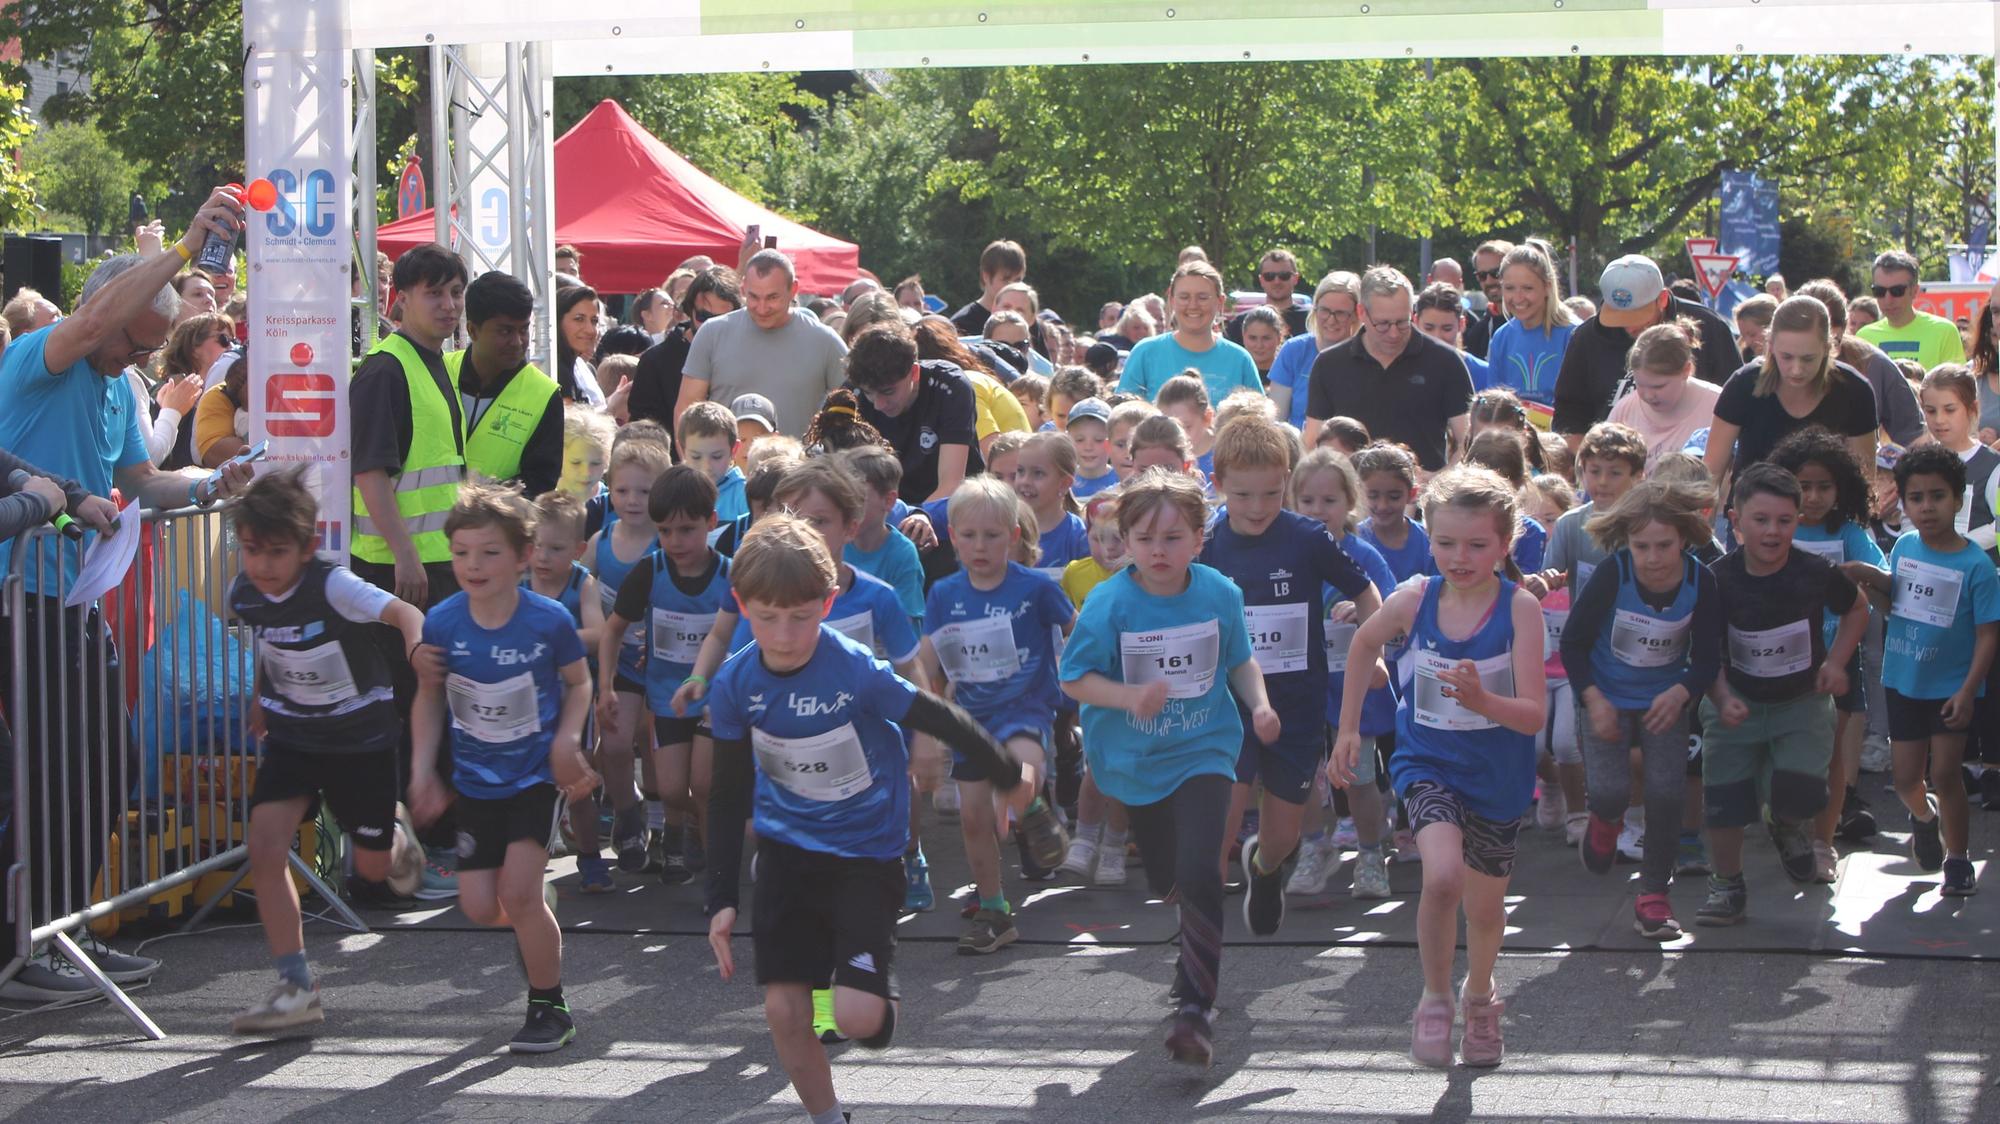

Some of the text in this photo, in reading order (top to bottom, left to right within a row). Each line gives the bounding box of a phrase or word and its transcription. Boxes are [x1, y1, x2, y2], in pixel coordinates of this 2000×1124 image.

[265, 237, 297, 246] Schmidt
[303, 237, 337, 246] Clemens
[265, 315, 337, 326] Kreissparkasse
[265, 327, 288, 337] Köln
[1273, 581, 1290, 598] LB
[1905, 582, 1935, 598] 158
[676, 631, 708, 642] 507
[1248, 631, 1282, 644] 510
[961, 643, 989, 655] 474
[1751, 645, 1785, 657] 524
[1155, 653, 1193, 669] 161
[784, 760, 829, 774] 528
